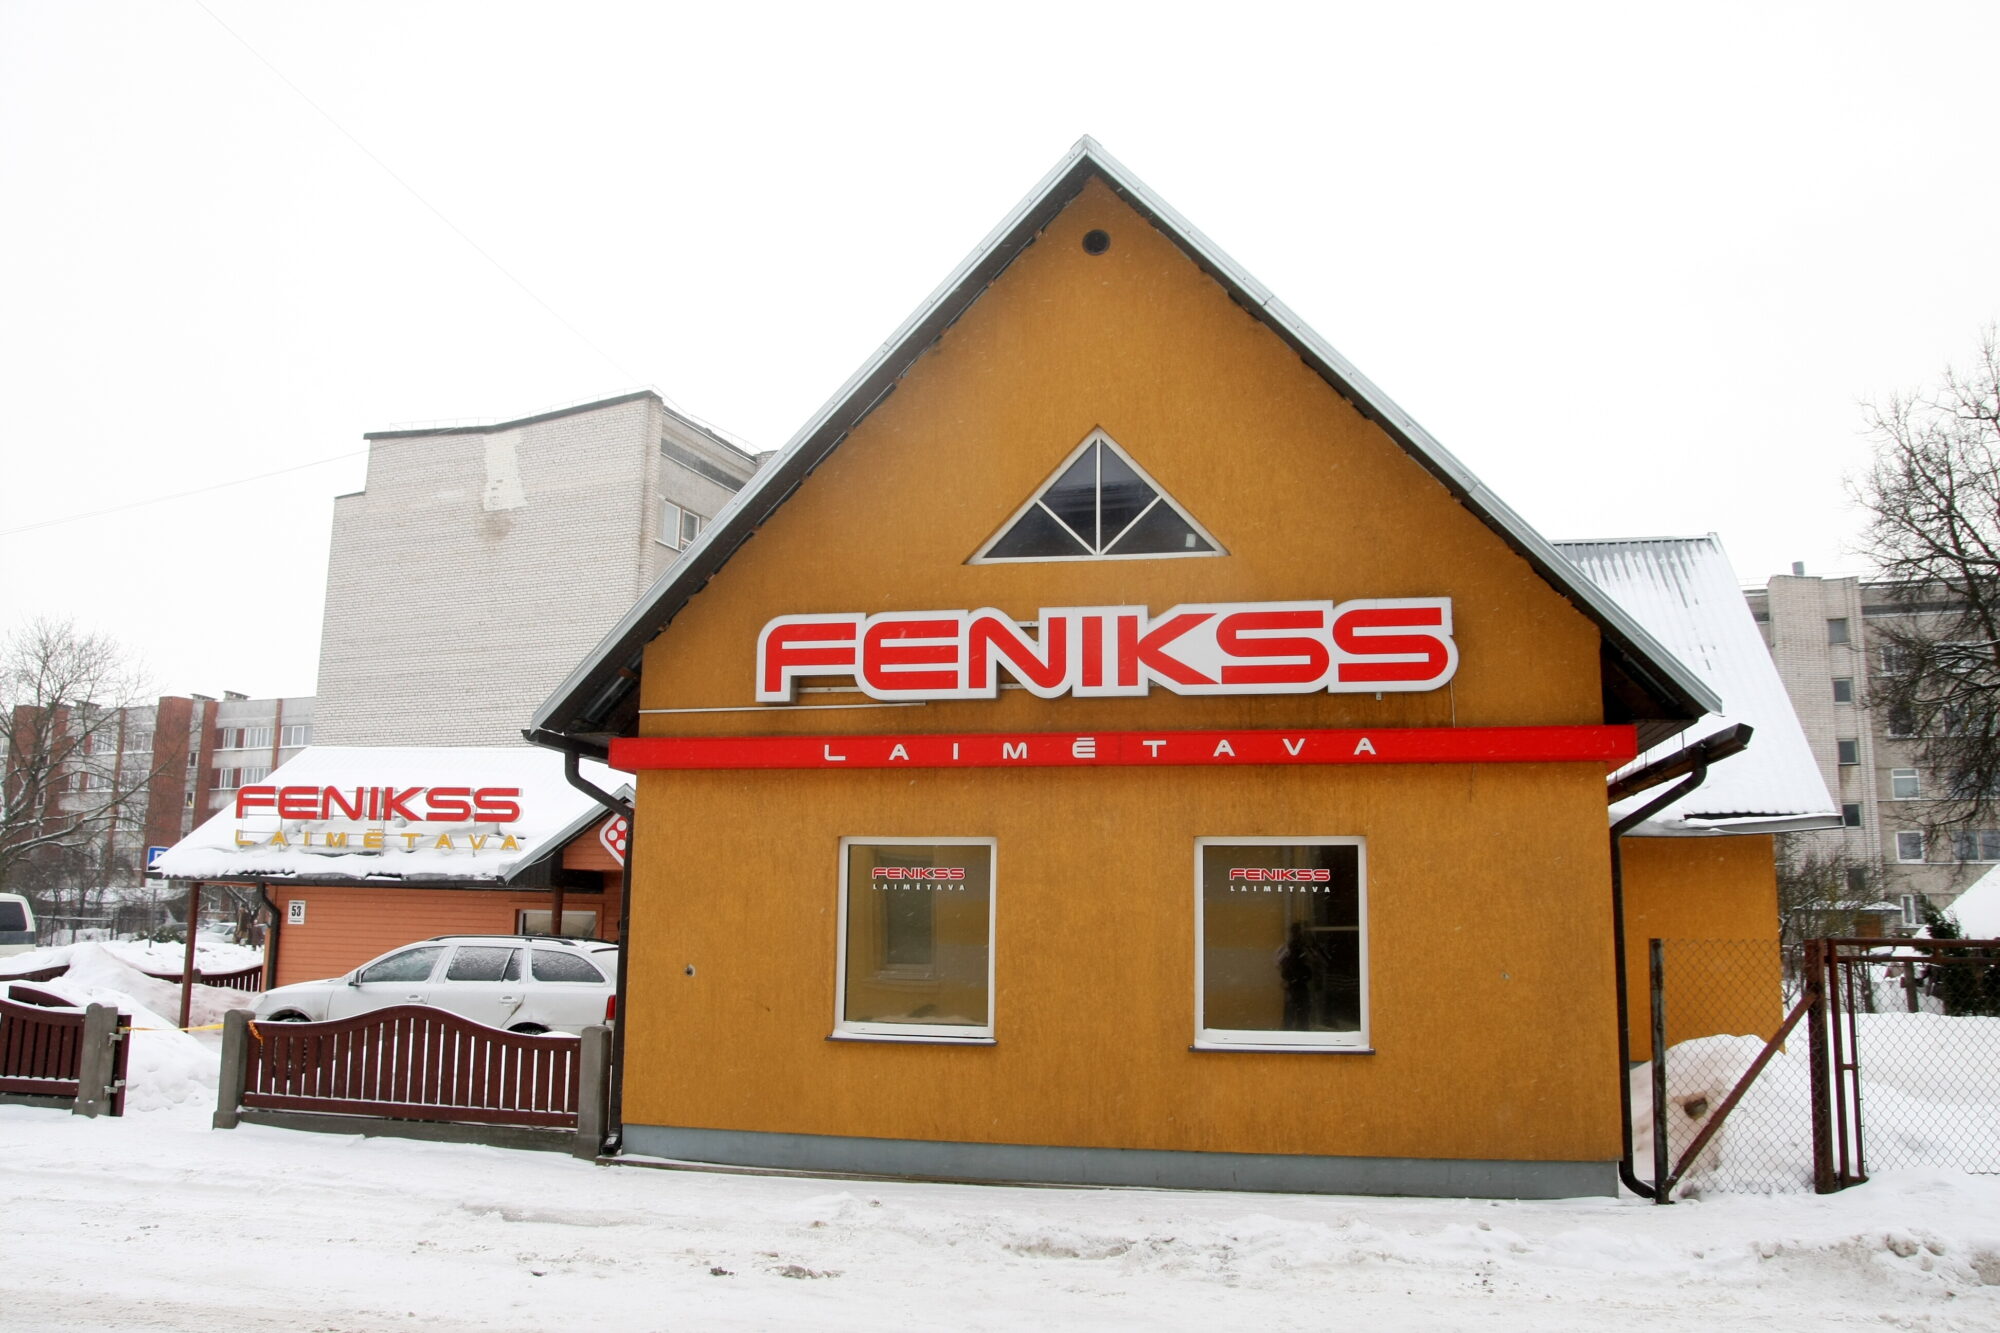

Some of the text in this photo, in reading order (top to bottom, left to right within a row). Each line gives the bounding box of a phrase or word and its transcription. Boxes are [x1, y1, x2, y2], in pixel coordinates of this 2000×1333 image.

[764, 606, 1450, 693] FENIKSS
[235, 785, 522, 823] FENIKSS
[872, 866, 966, 880] FENIKSS
[1229, 867, 1331, 882] FENIKSS
[291, 905, 302, 917] 53
